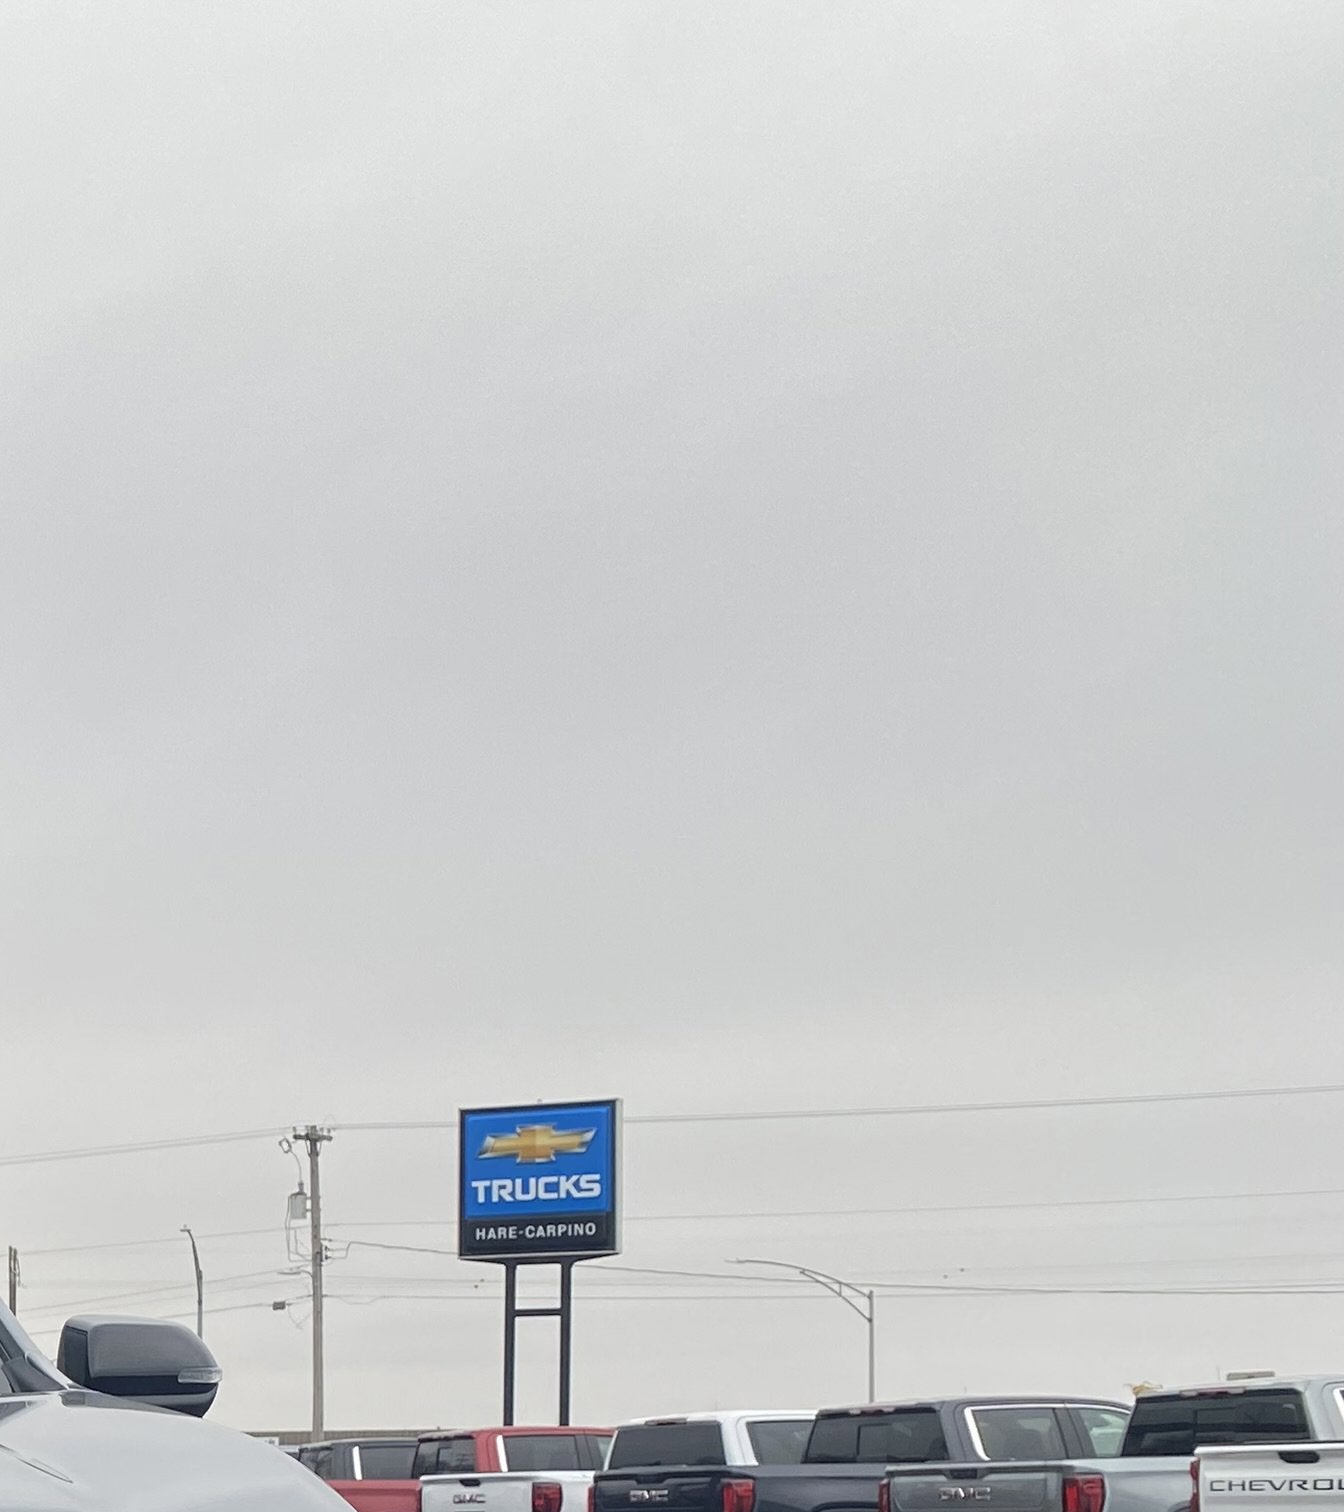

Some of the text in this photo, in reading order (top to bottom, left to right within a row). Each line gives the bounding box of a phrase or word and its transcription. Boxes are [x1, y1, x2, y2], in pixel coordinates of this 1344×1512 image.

[471, 1173, 601, 1204] TRUCKS
[475, 1222, 597, 1241] HARE-CARPINO
[938, 1486, 992, 1501] GMC
